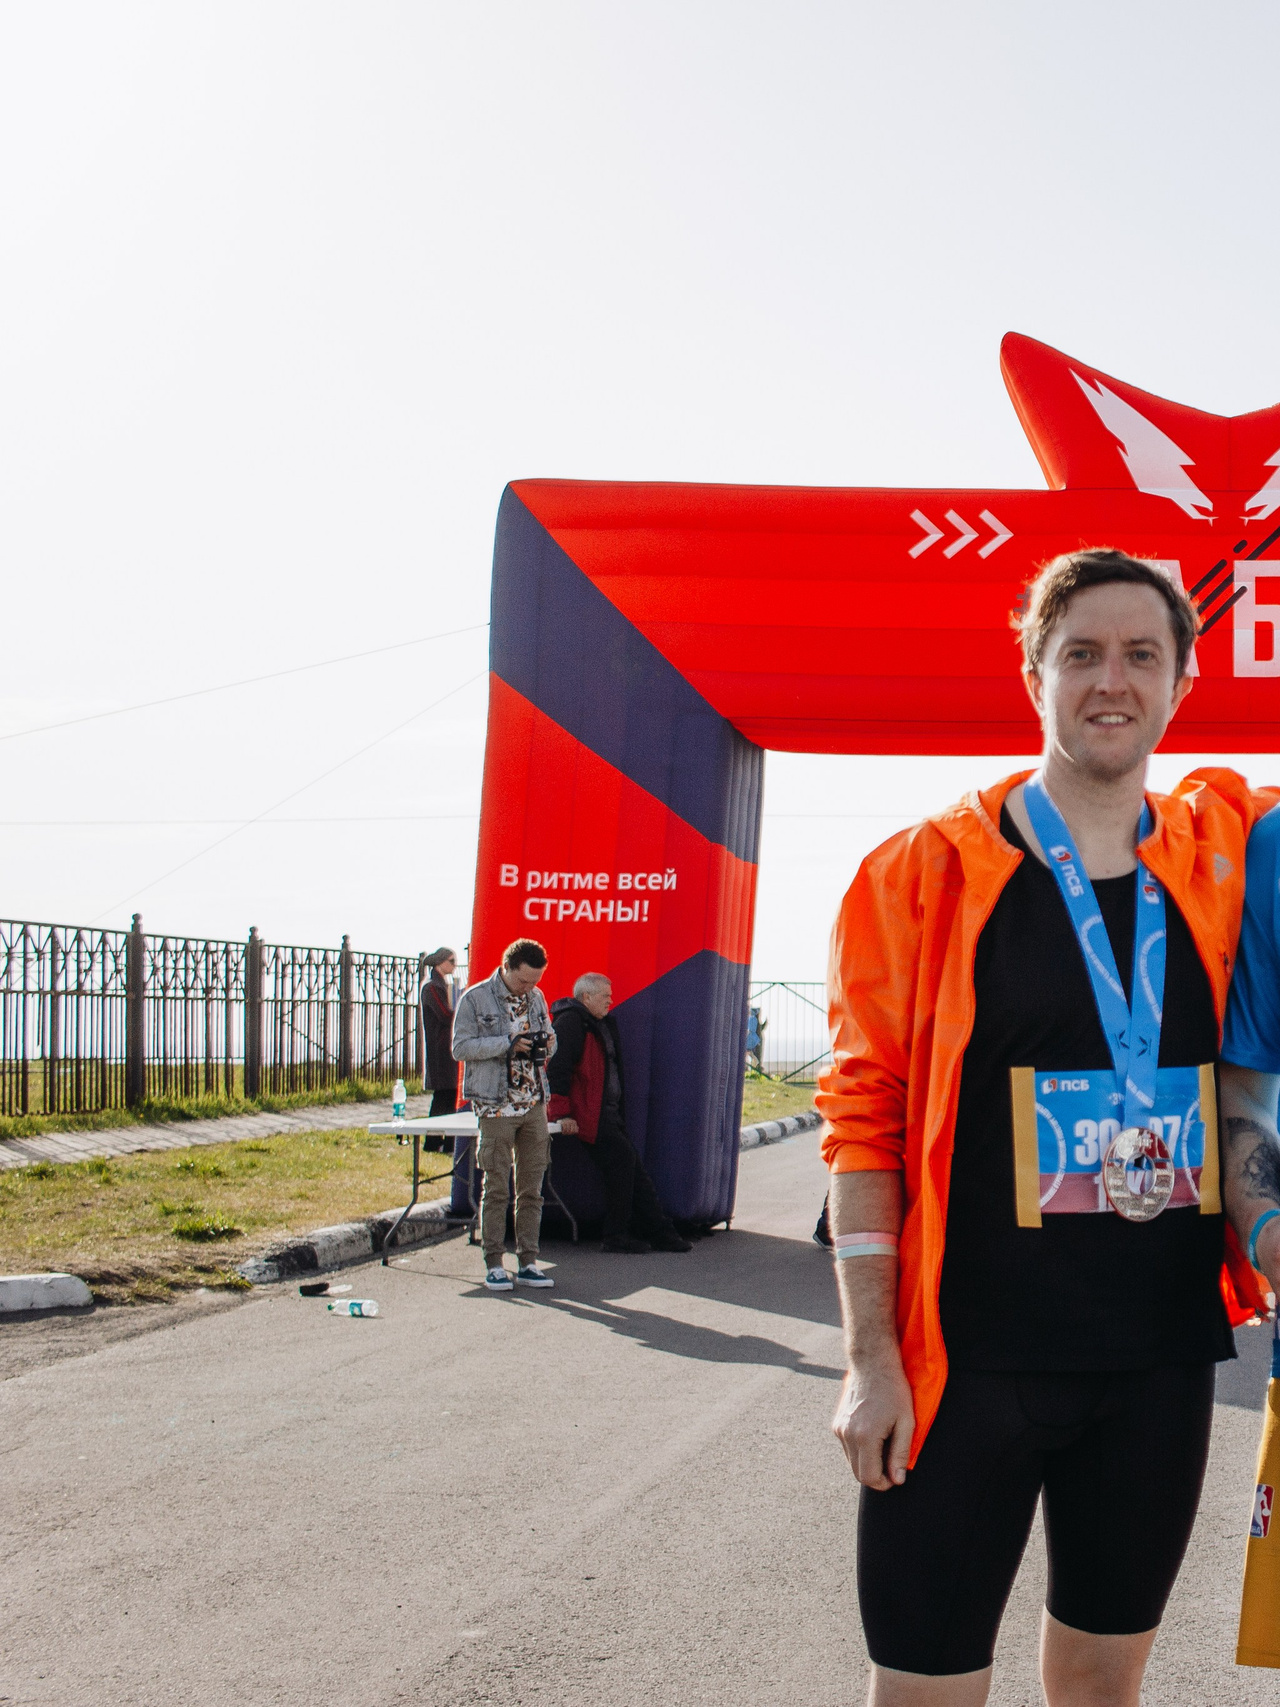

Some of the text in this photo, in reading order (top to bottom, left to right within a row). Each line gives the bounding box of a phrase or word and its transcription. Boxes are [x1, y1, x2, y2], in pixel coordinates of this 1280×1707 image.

[500, 863, 678, 892] В ритме всей
[1061, 863, 1084, 898] ПСБ
[523, 897, 650, 923] СТРАНЫ!
[1060, 1079, 1090, 1091] ПСБ
